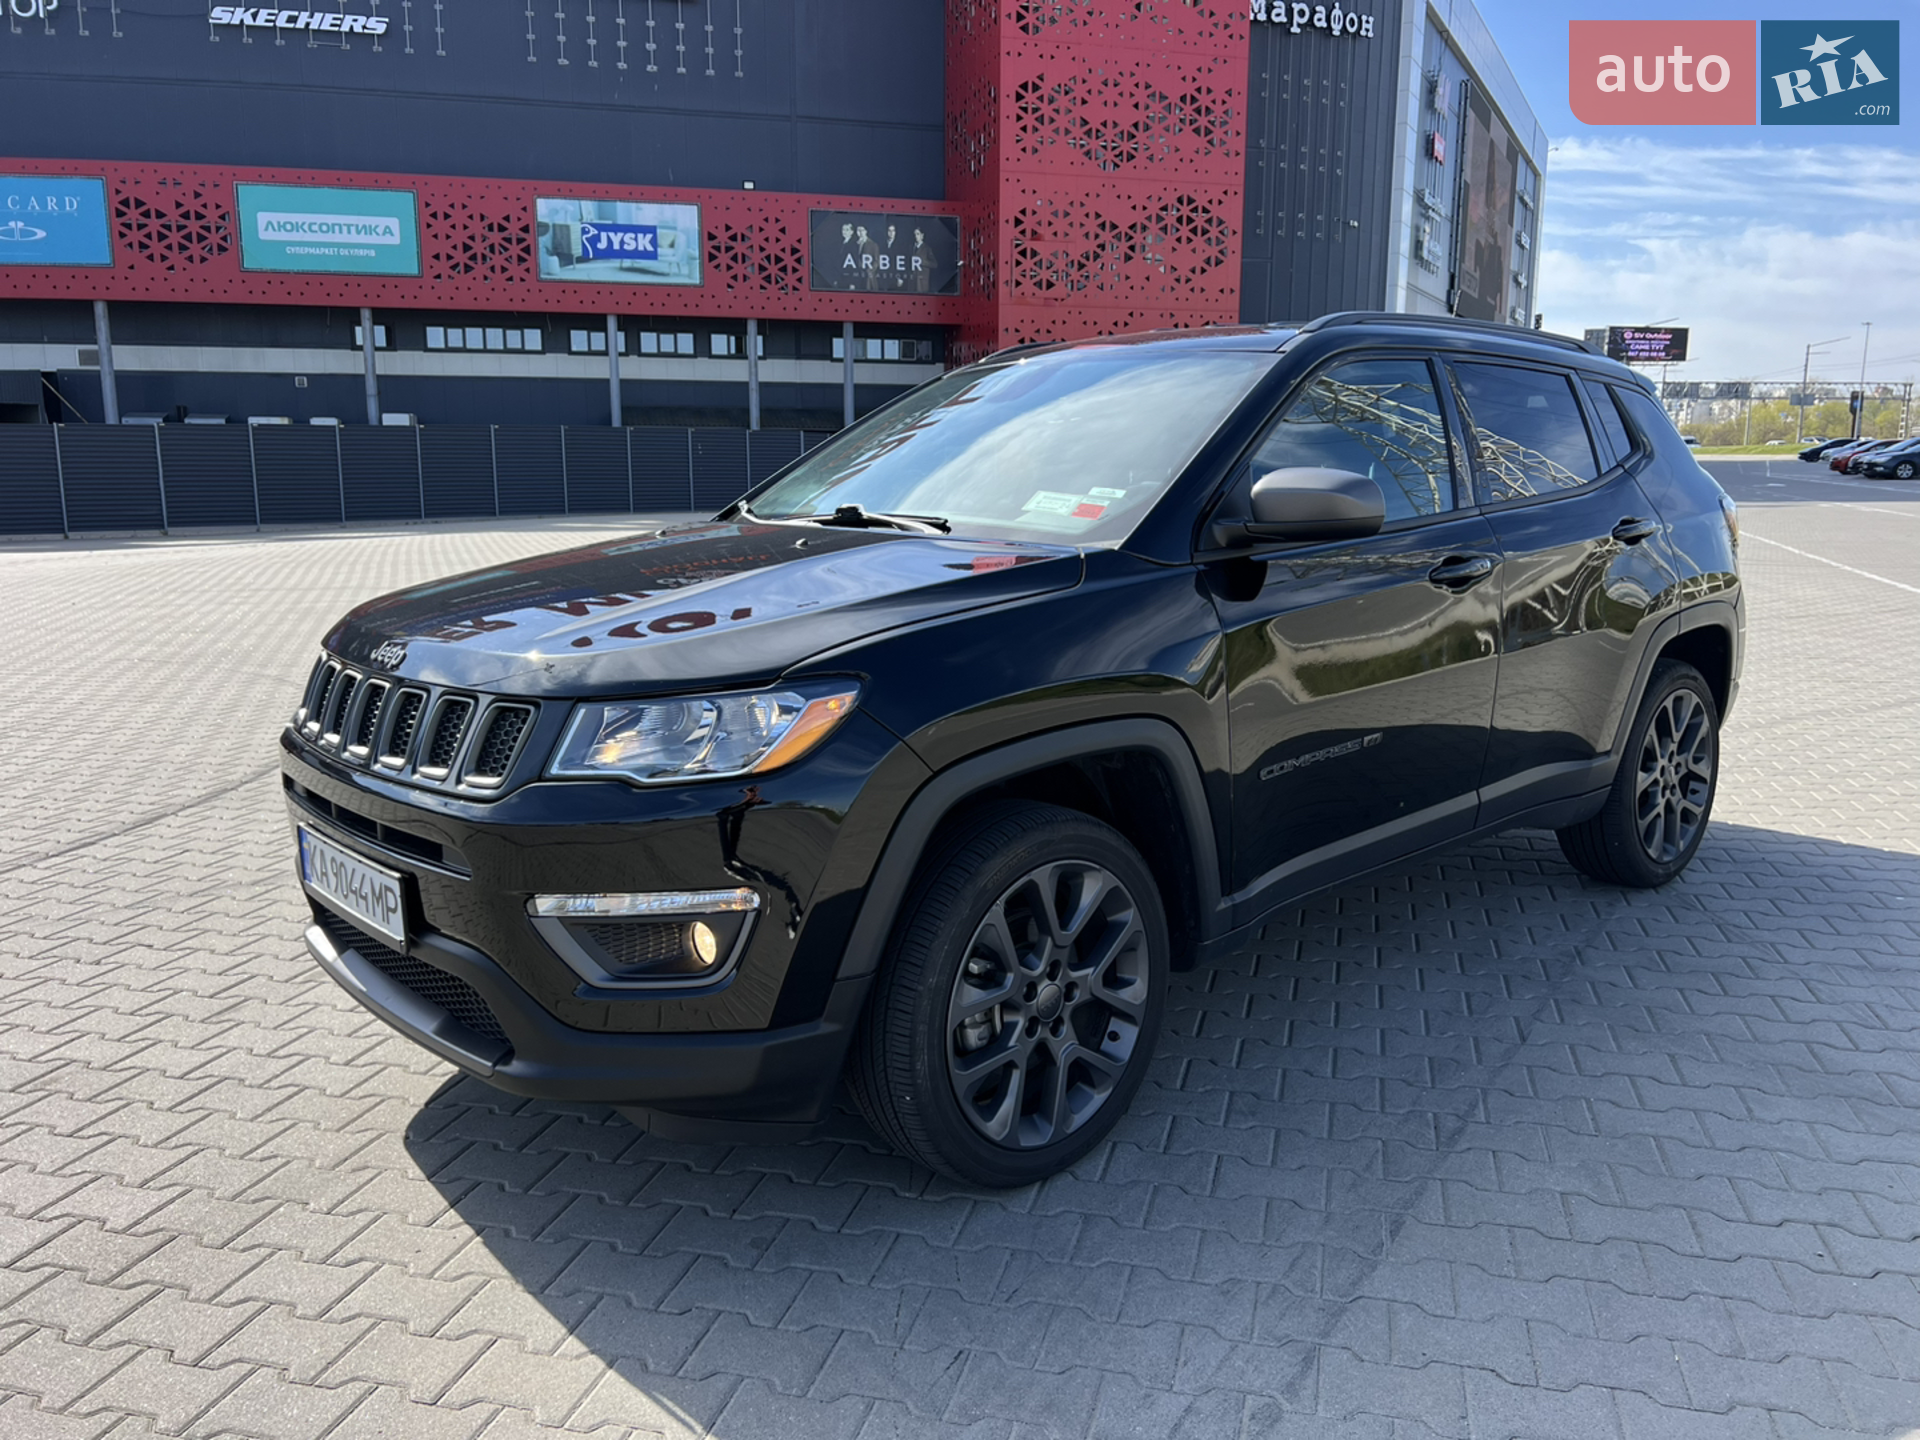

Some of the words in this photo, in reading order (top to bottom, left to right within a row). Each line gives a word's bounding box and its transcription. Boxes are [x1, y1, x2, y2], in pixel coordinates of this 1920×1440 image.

[209, 6, 389, 35] SKECHERS
[1250, 0, 1374, 38] Марафон
[7, 194, 78, 211] CARD
[263, 219, 396, 238] ЛЮКСОПТИКА
[285, 246, 338, 256] СУПЕРМАРКЕТ
[339, 248, 376, 258] ОКУЛЯРІВ
[596, 231, 655, 252] JYSK
[842, 252, 923, 272] ARBER
[370, 640, 407, 669] Jeep
[1259, 737, 1363, 781] COMPASS
